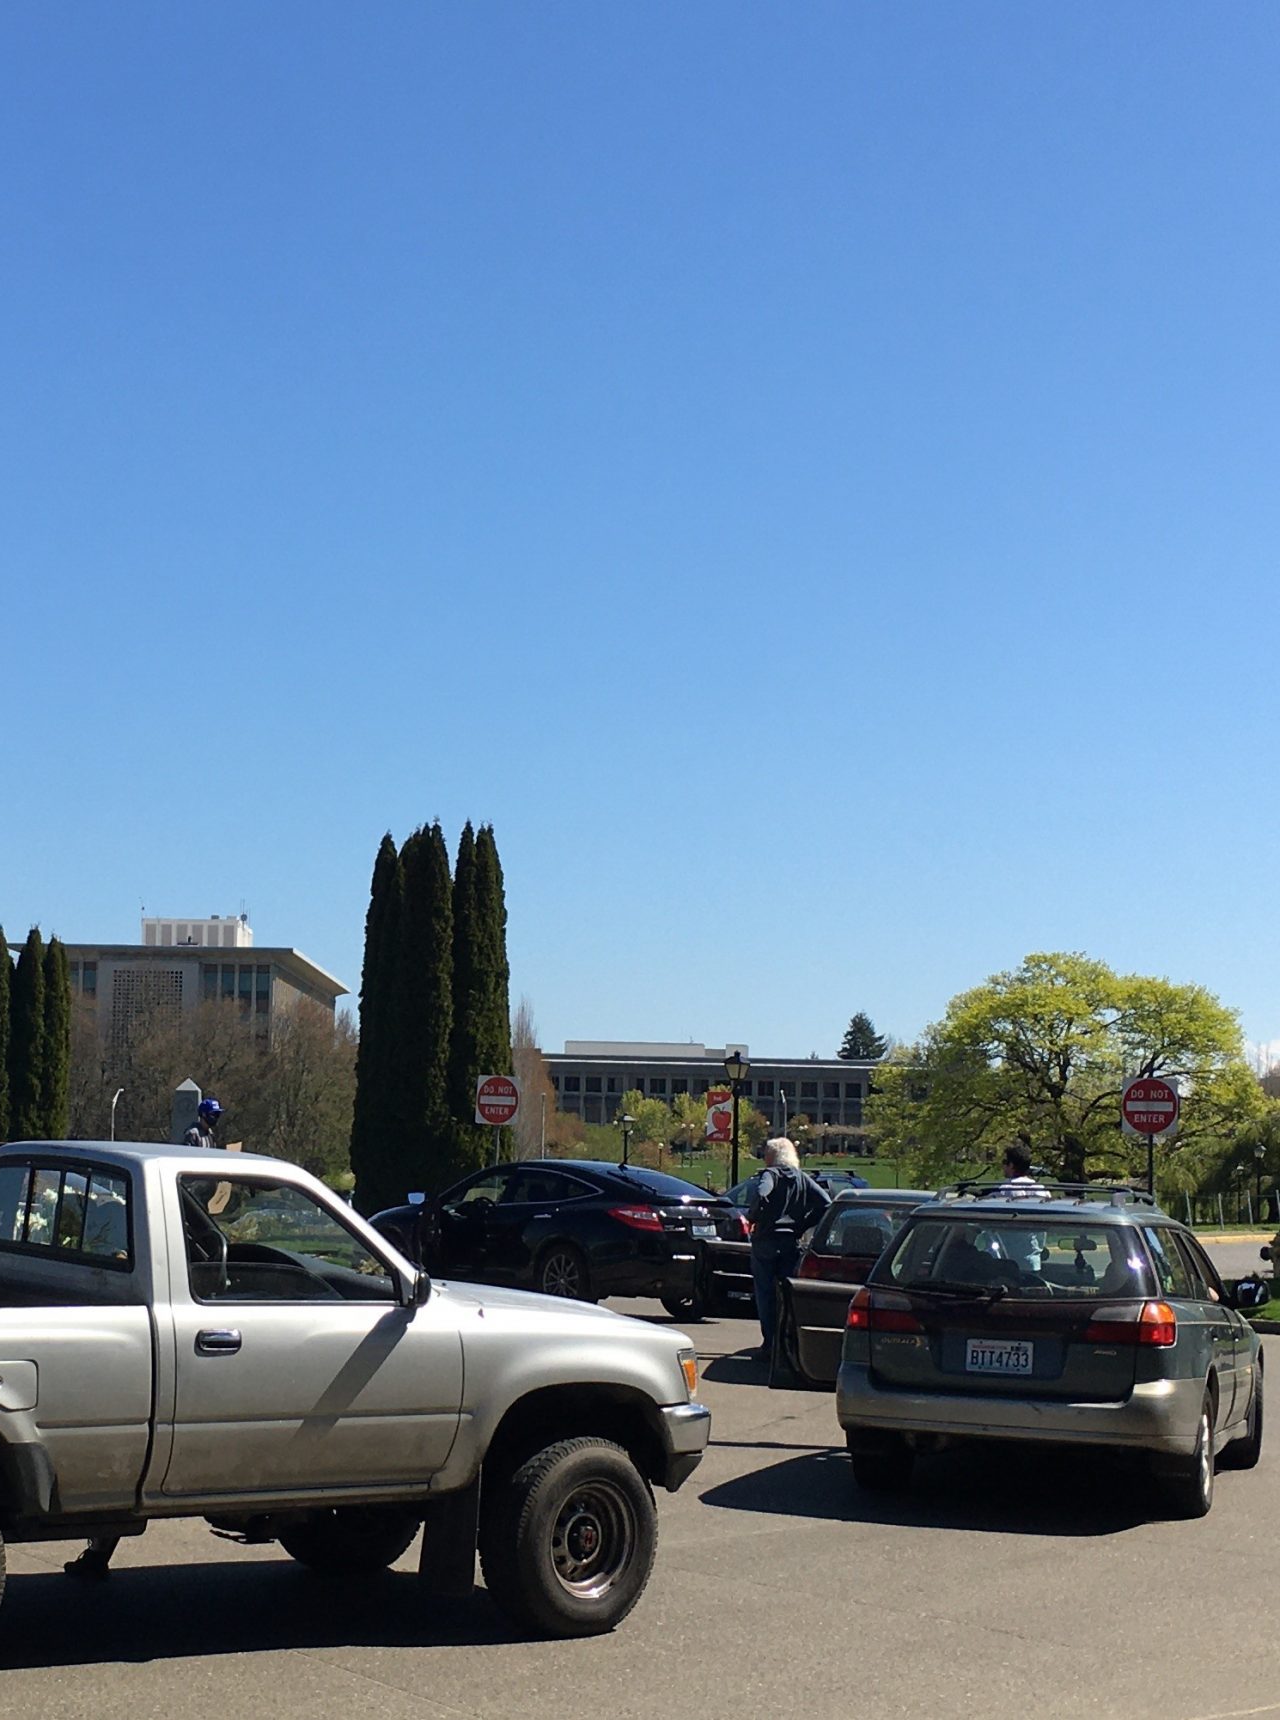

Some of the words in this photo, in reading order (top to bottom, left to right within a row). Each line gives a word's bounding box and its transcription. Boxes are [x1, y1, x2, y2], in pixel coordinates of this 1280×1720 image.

[484, 1085, 494, 1094] DO
[498, 1086, 513, 1095] NOT
[1131, 1089, 1144, 1098] DO
[1150, 1090, 1169, 1100] NOT
[485, 1107, 509, 1115] ENTER
[1134, 1113, 1166, 1124] ENTER
